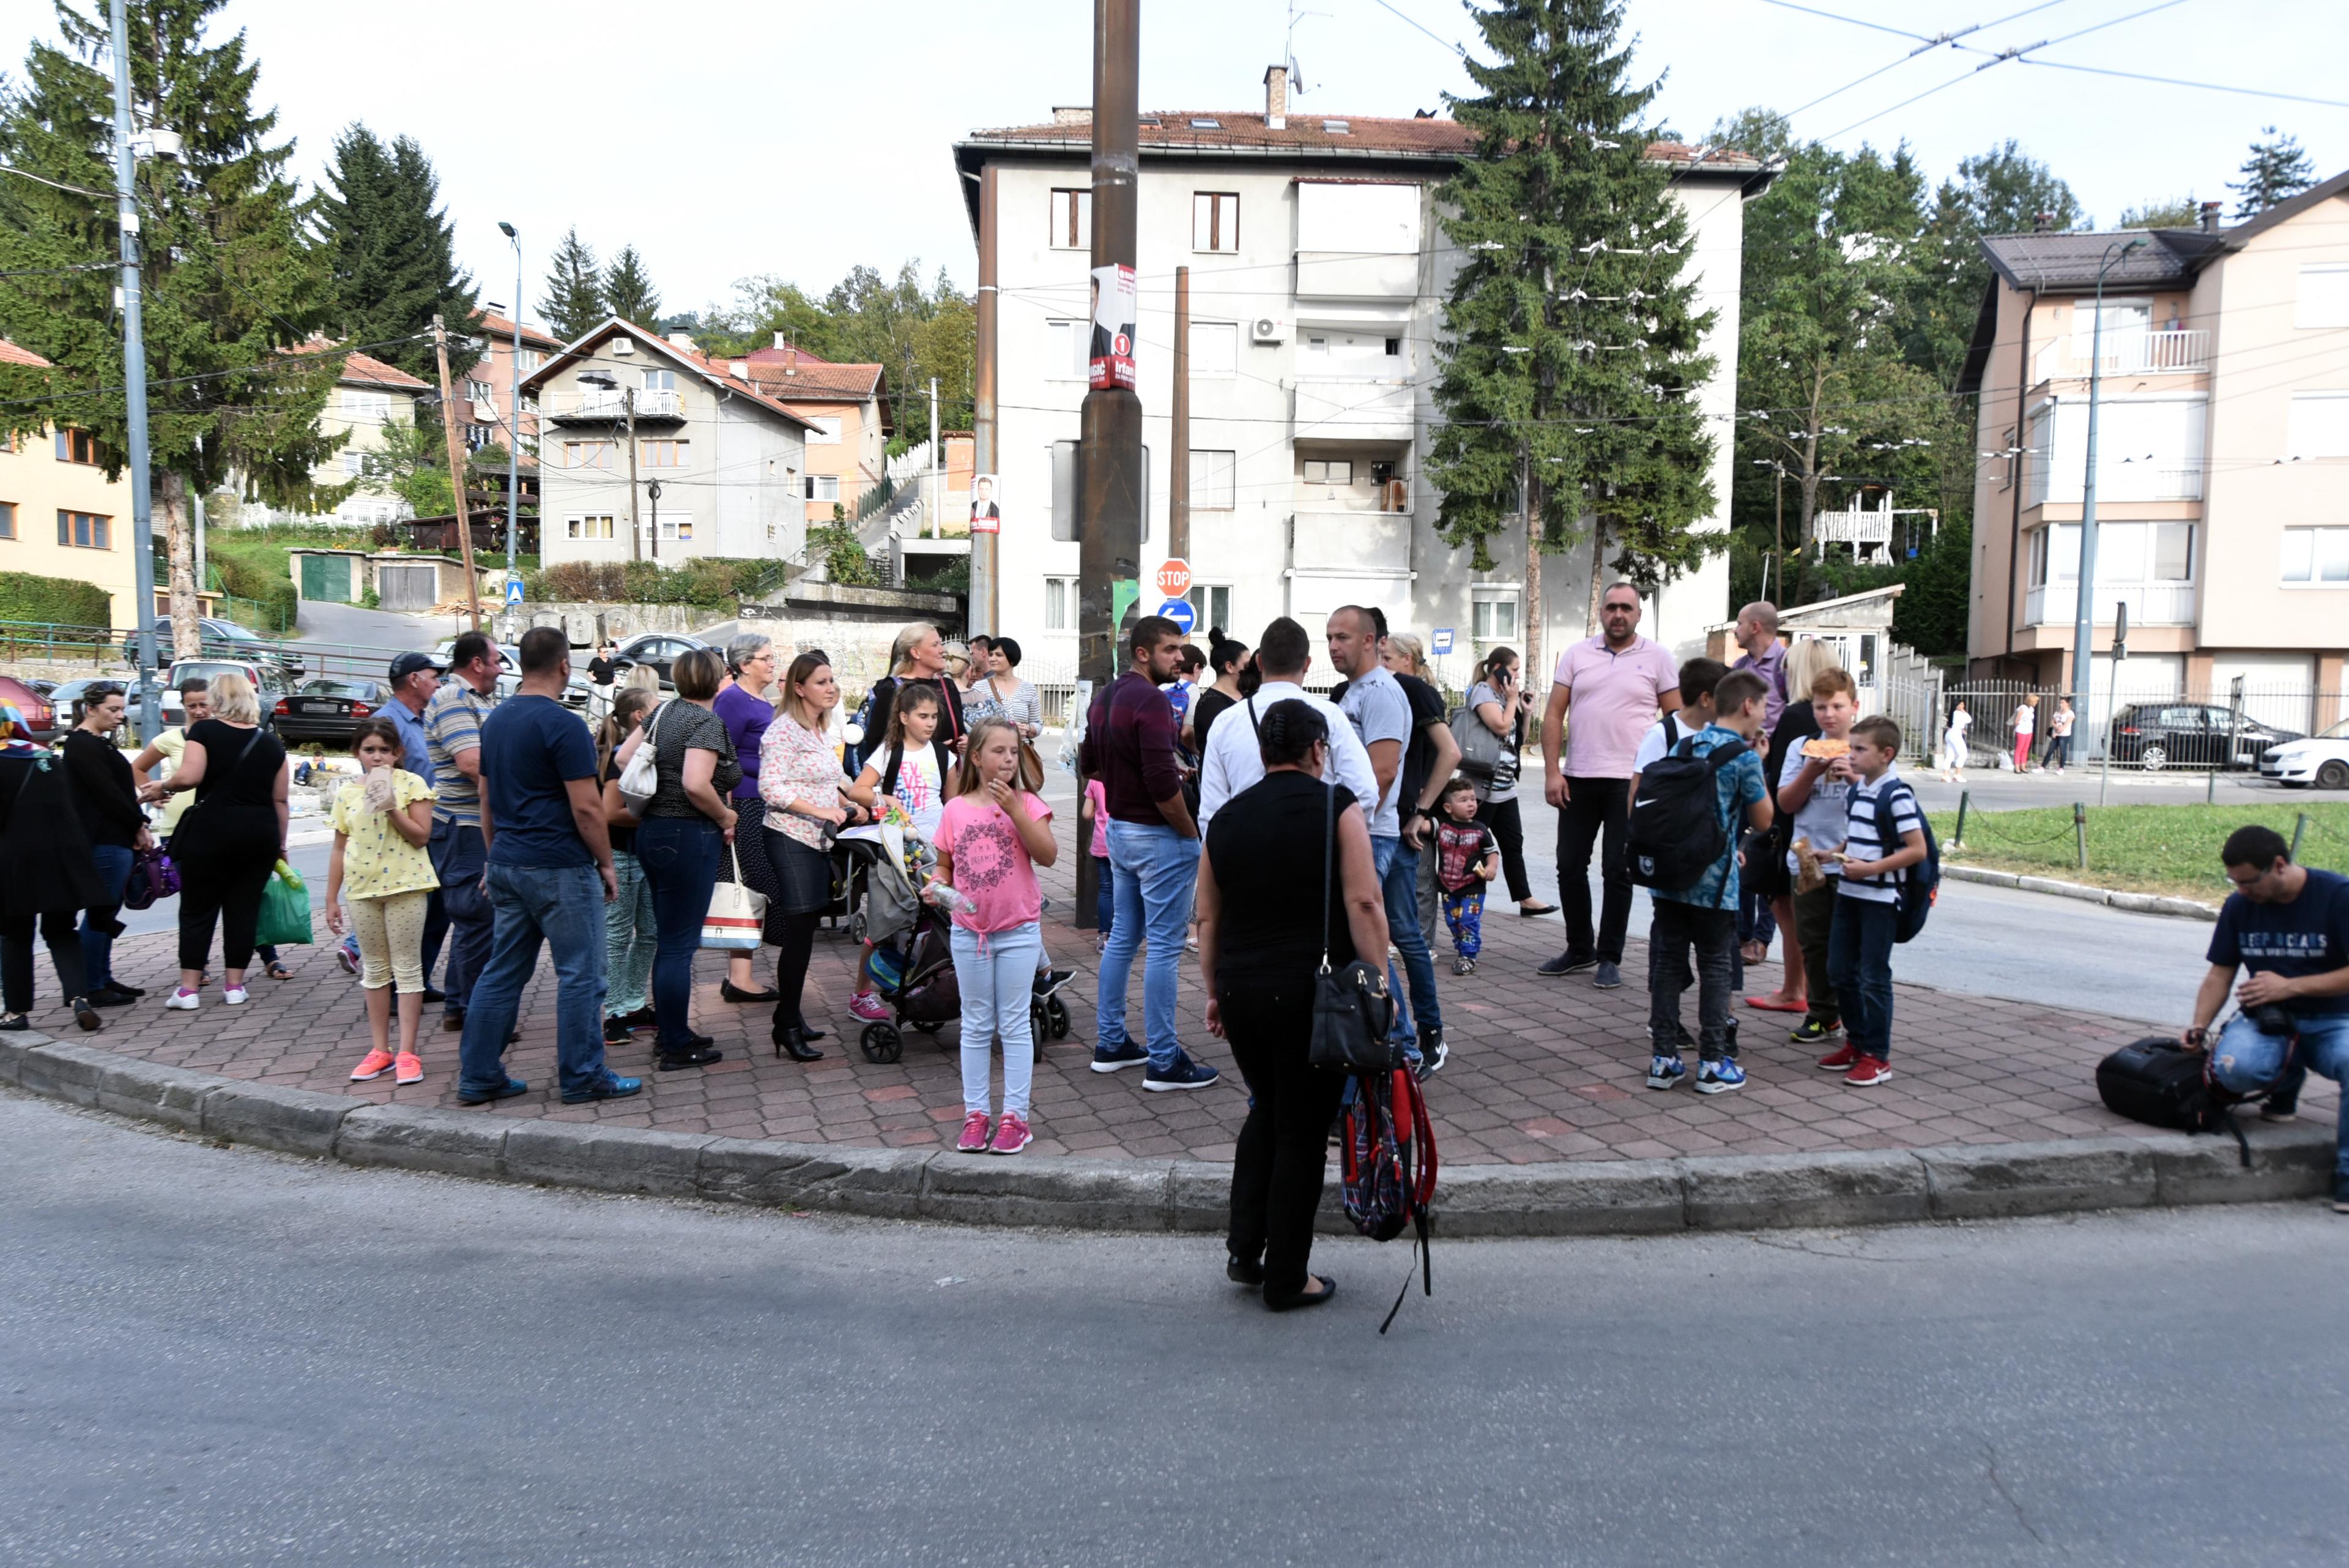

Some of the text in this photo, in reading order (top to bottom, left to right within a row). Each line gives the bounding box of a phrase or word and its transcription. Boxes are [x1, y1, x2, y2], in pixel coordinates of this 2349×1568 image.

[1119, 337, 1125, 352] 1
[1115, 360, 1134, 377] Irfan
[1158, 571, 1190, 586] STOP
[987, 844, 991, 852] A
